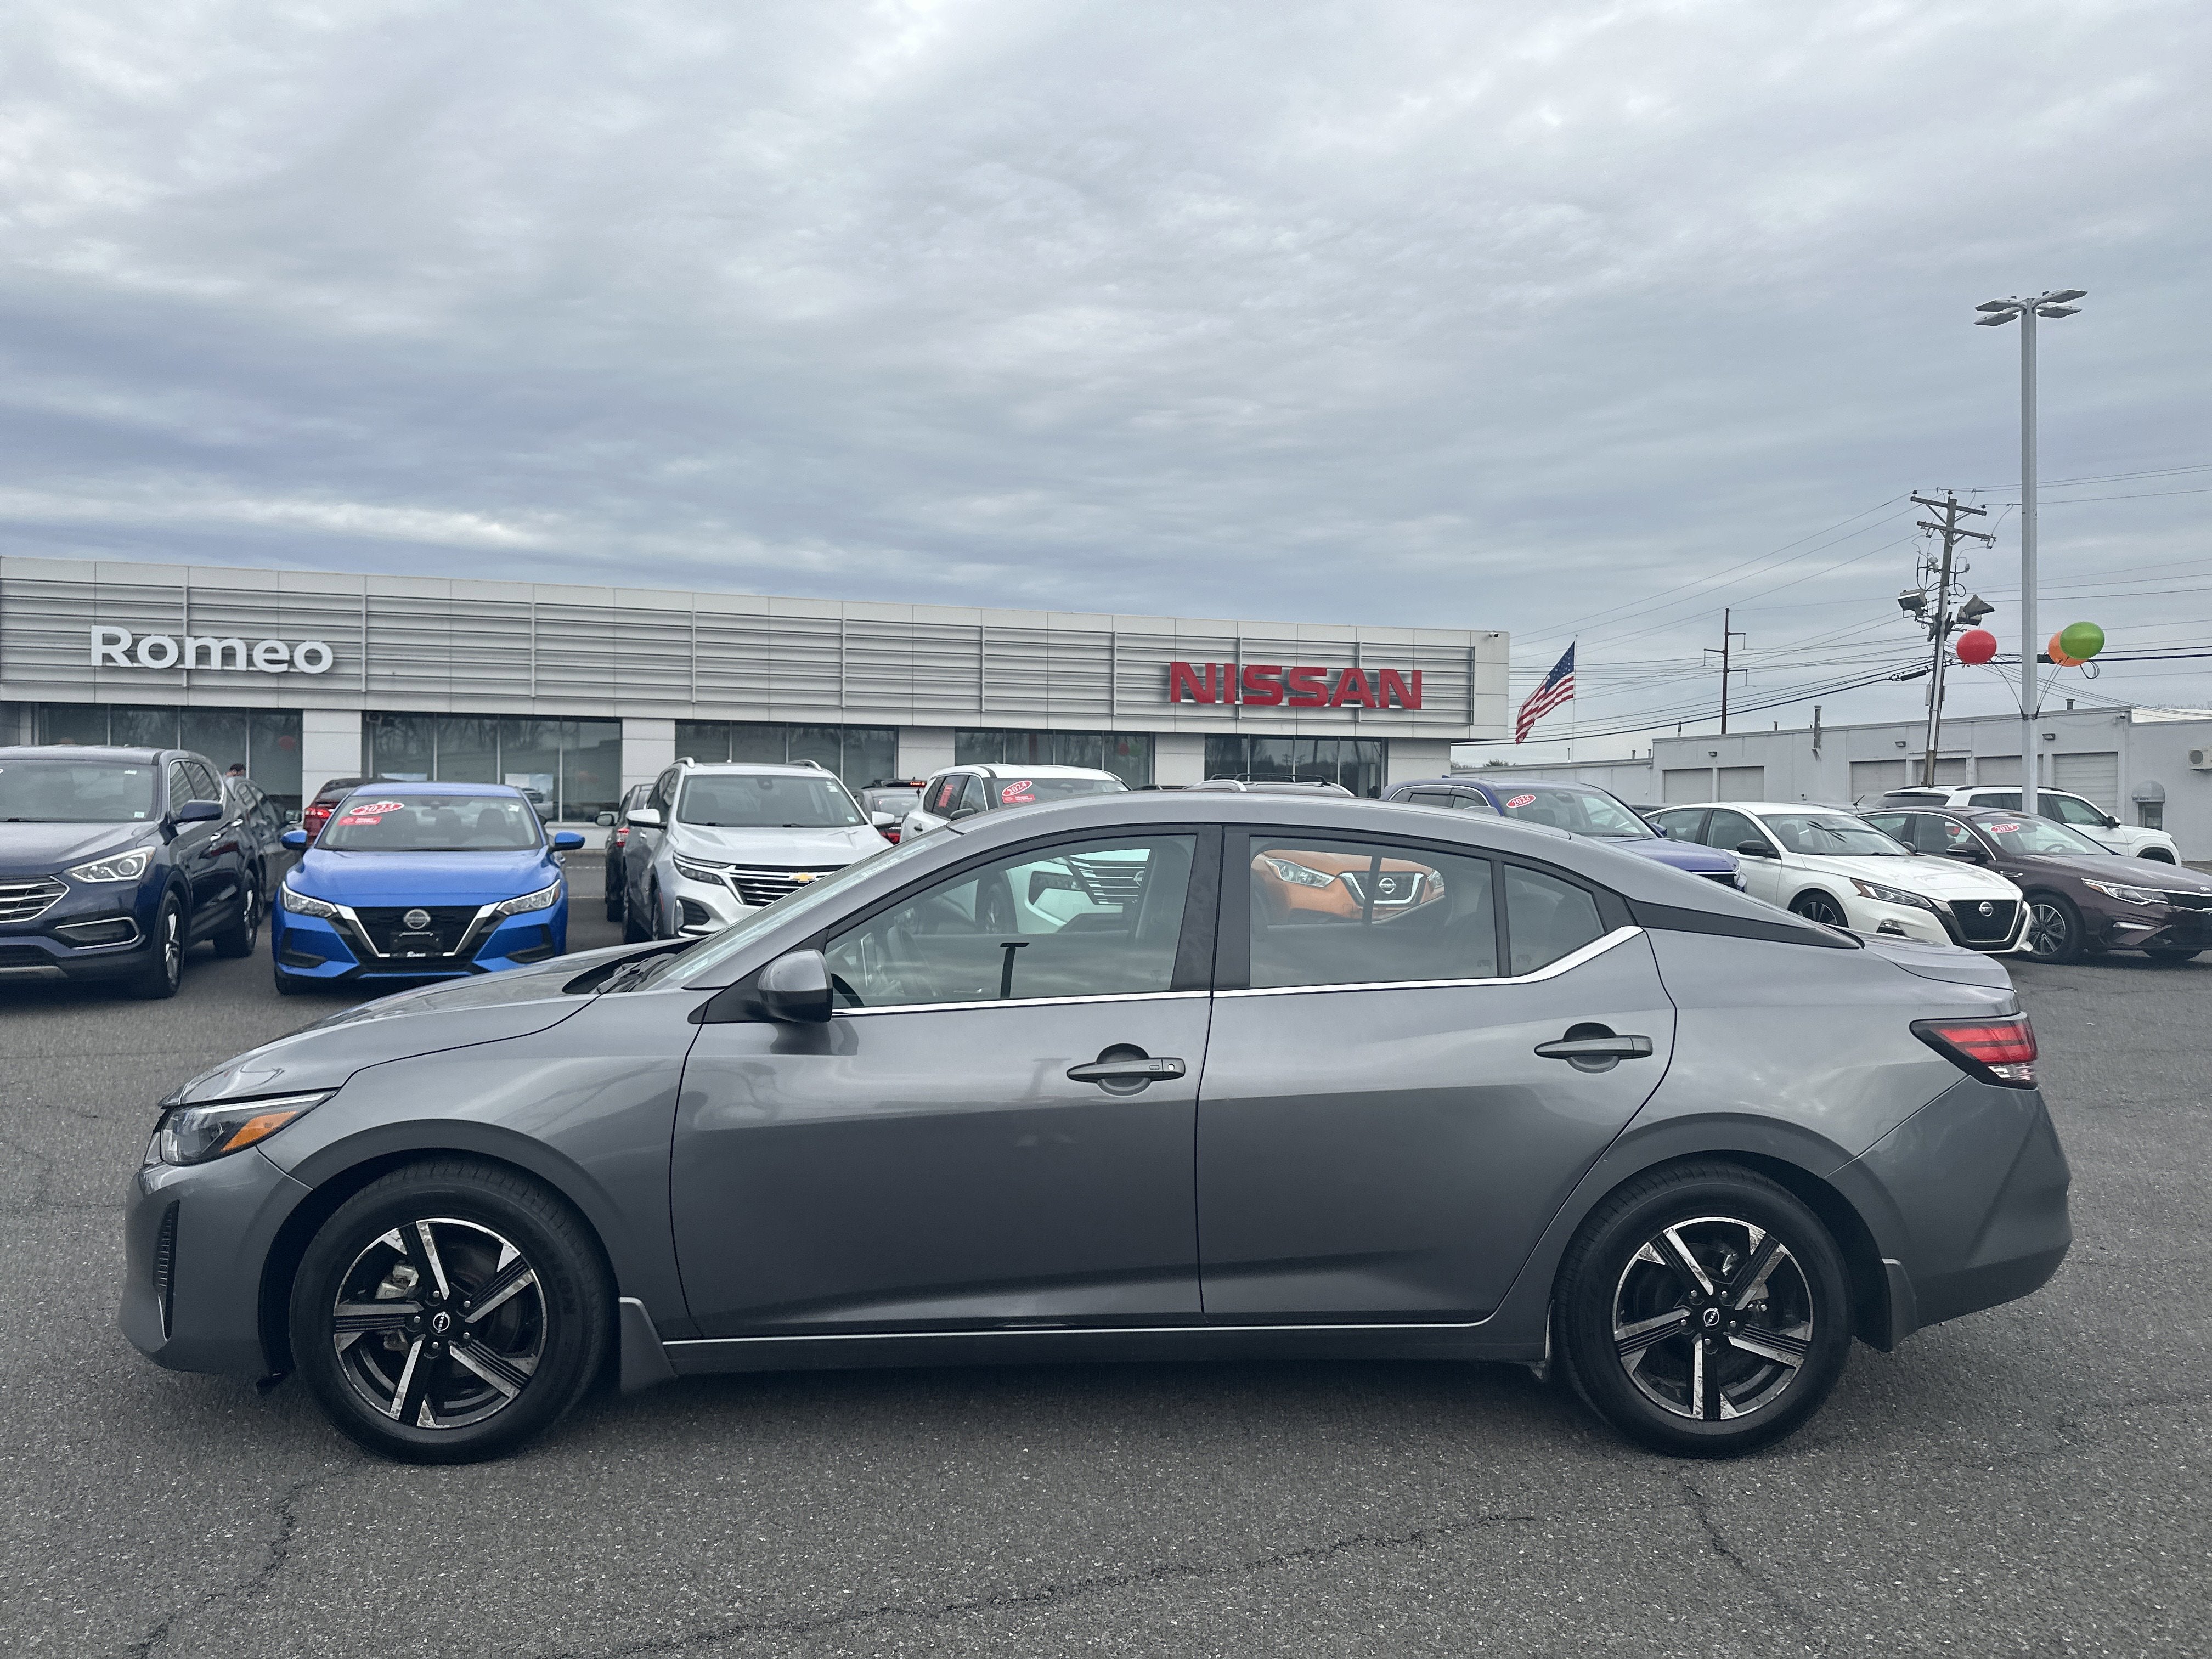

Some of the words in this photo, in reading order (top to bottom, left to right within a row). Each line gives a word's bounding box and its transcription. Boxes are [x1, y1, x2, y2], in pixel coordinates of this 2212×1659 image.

[91, 625, 334, 674] Romeo
[1170, 662, 1422, 709] NISSAN
[1007, 781, 1027, 794] 2024
[1512, 795, 1531, 806] 2023
[1705, 1307, 1718, 1327] NISSAN
